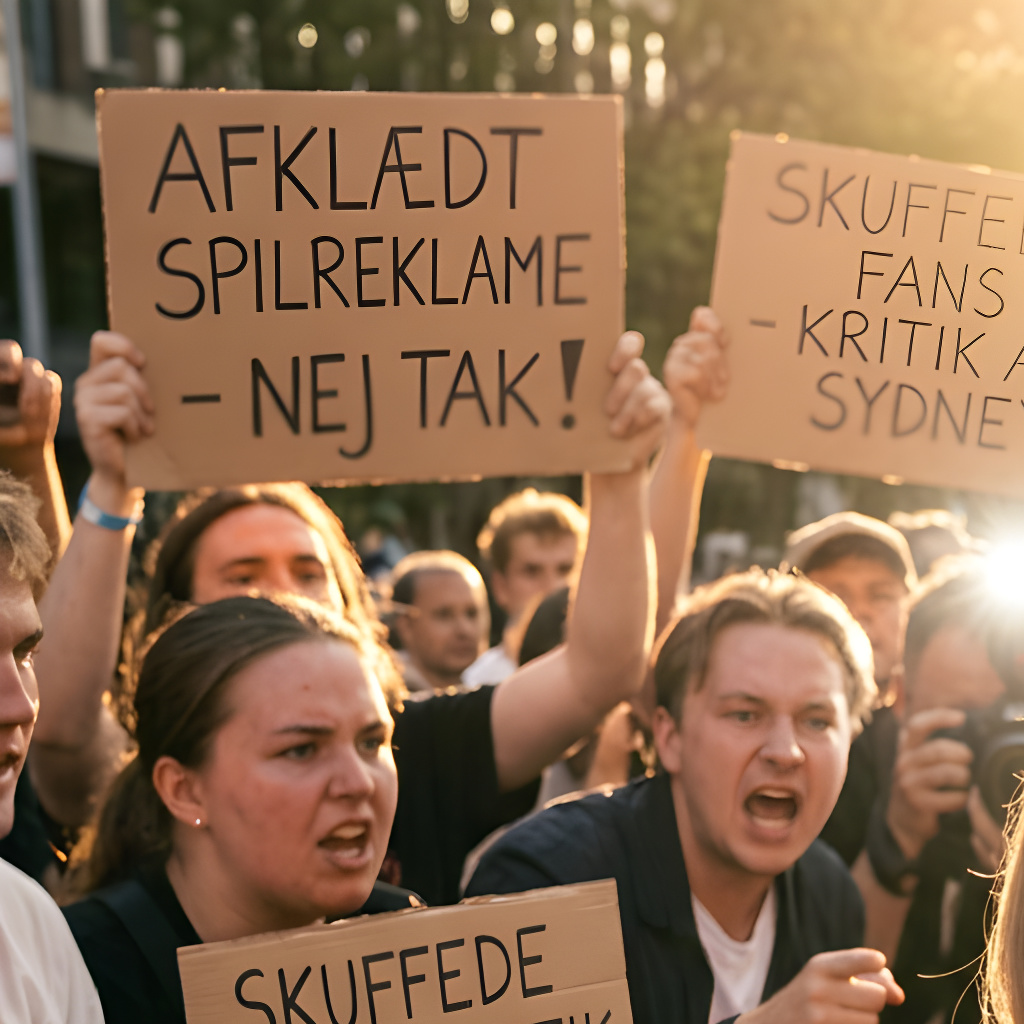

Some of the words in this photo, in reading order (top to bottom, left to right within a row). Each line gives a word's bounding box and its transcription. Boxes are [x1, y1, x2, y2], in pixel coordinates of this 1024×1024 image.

[149, 123, 543, 213] AFKLÆDT
[155, 234, 590, 319] SPILREKLAME
[857, 251, 1005, 318] FANS
[797, 304, 986, 379] KRITIK
[251, 353, 374, 459] NEJ
